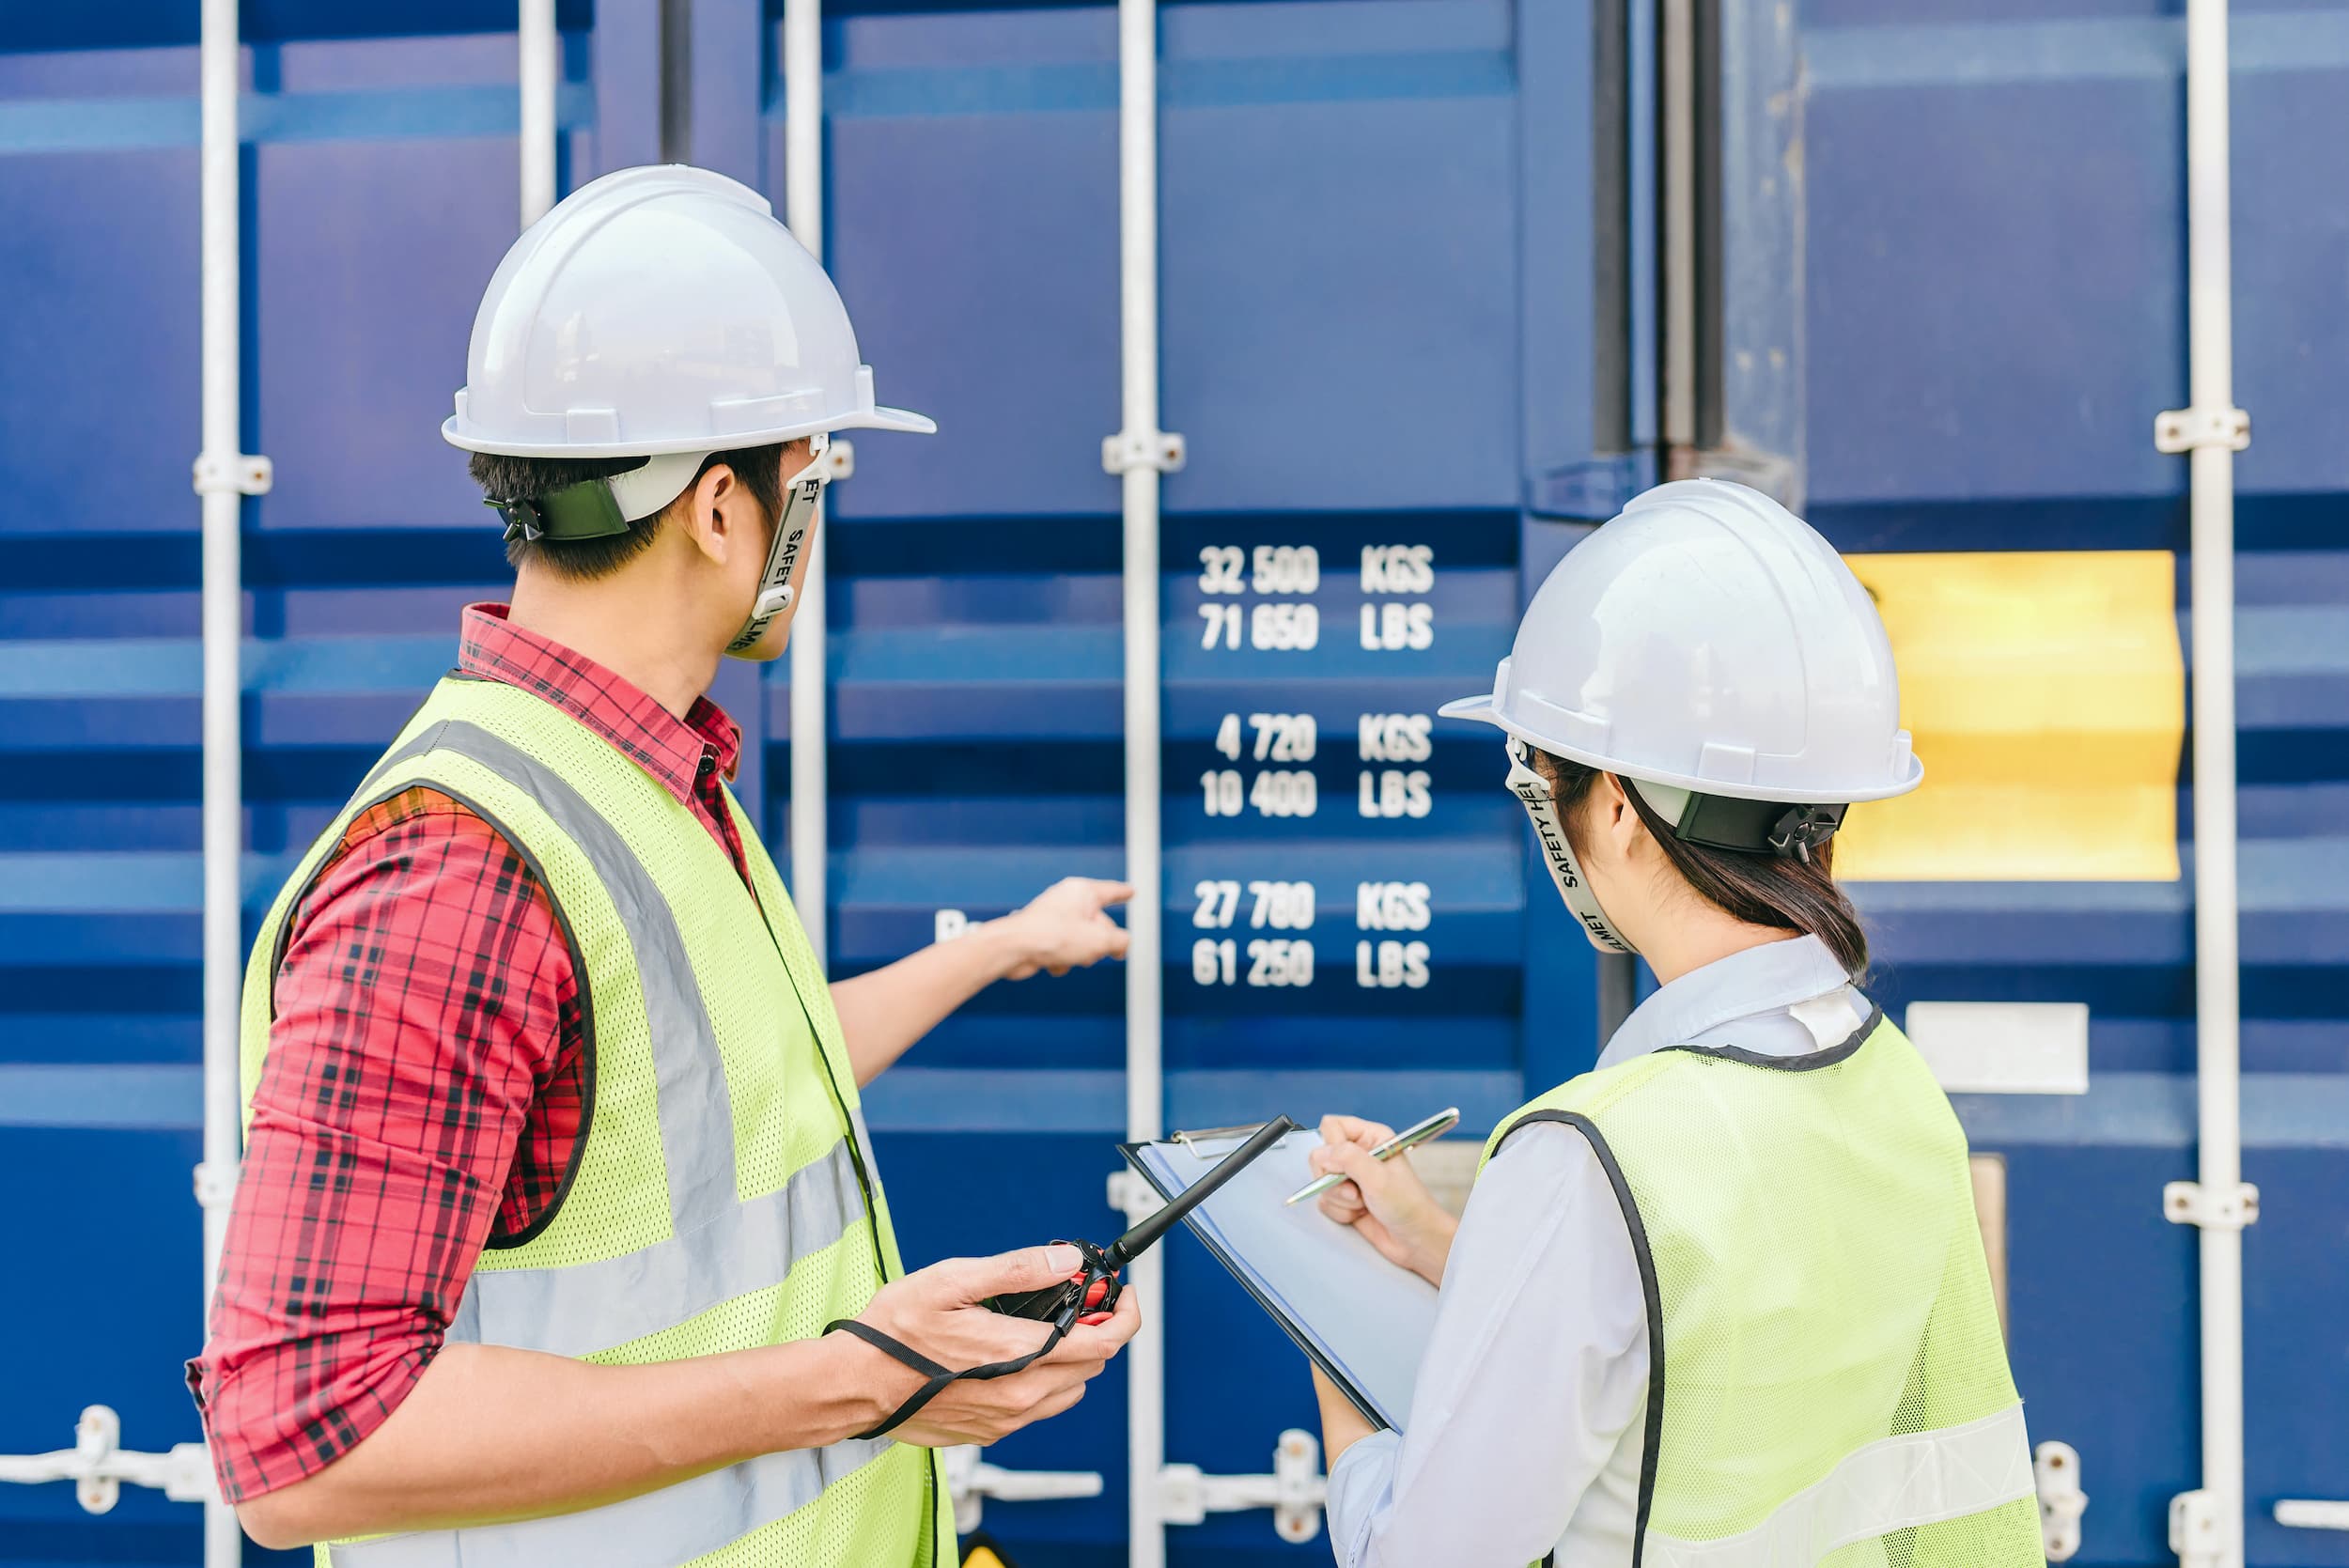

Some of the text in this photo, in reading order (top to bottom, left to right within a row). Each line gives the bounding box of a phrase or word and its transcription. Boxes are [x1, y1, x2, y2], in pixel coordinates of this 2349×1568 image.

[772, 528, 803, 600] SAFET
[1199, 545, 1434, 594] 32 500 KGS
[1198, 603, 1434, 650] 71 650 LBS
[1217, 714, 1432, 761] 4 720 KGS
[1202, 770, 1431, 817] 10 400 LBS
[1534, 816, 1579, 888] SAFETY
[1193, 880, 1241, 928] 27
[1357, 881, 1431, 930] KGS
[1192, 939, 1430, 986] 61 250 LBS
